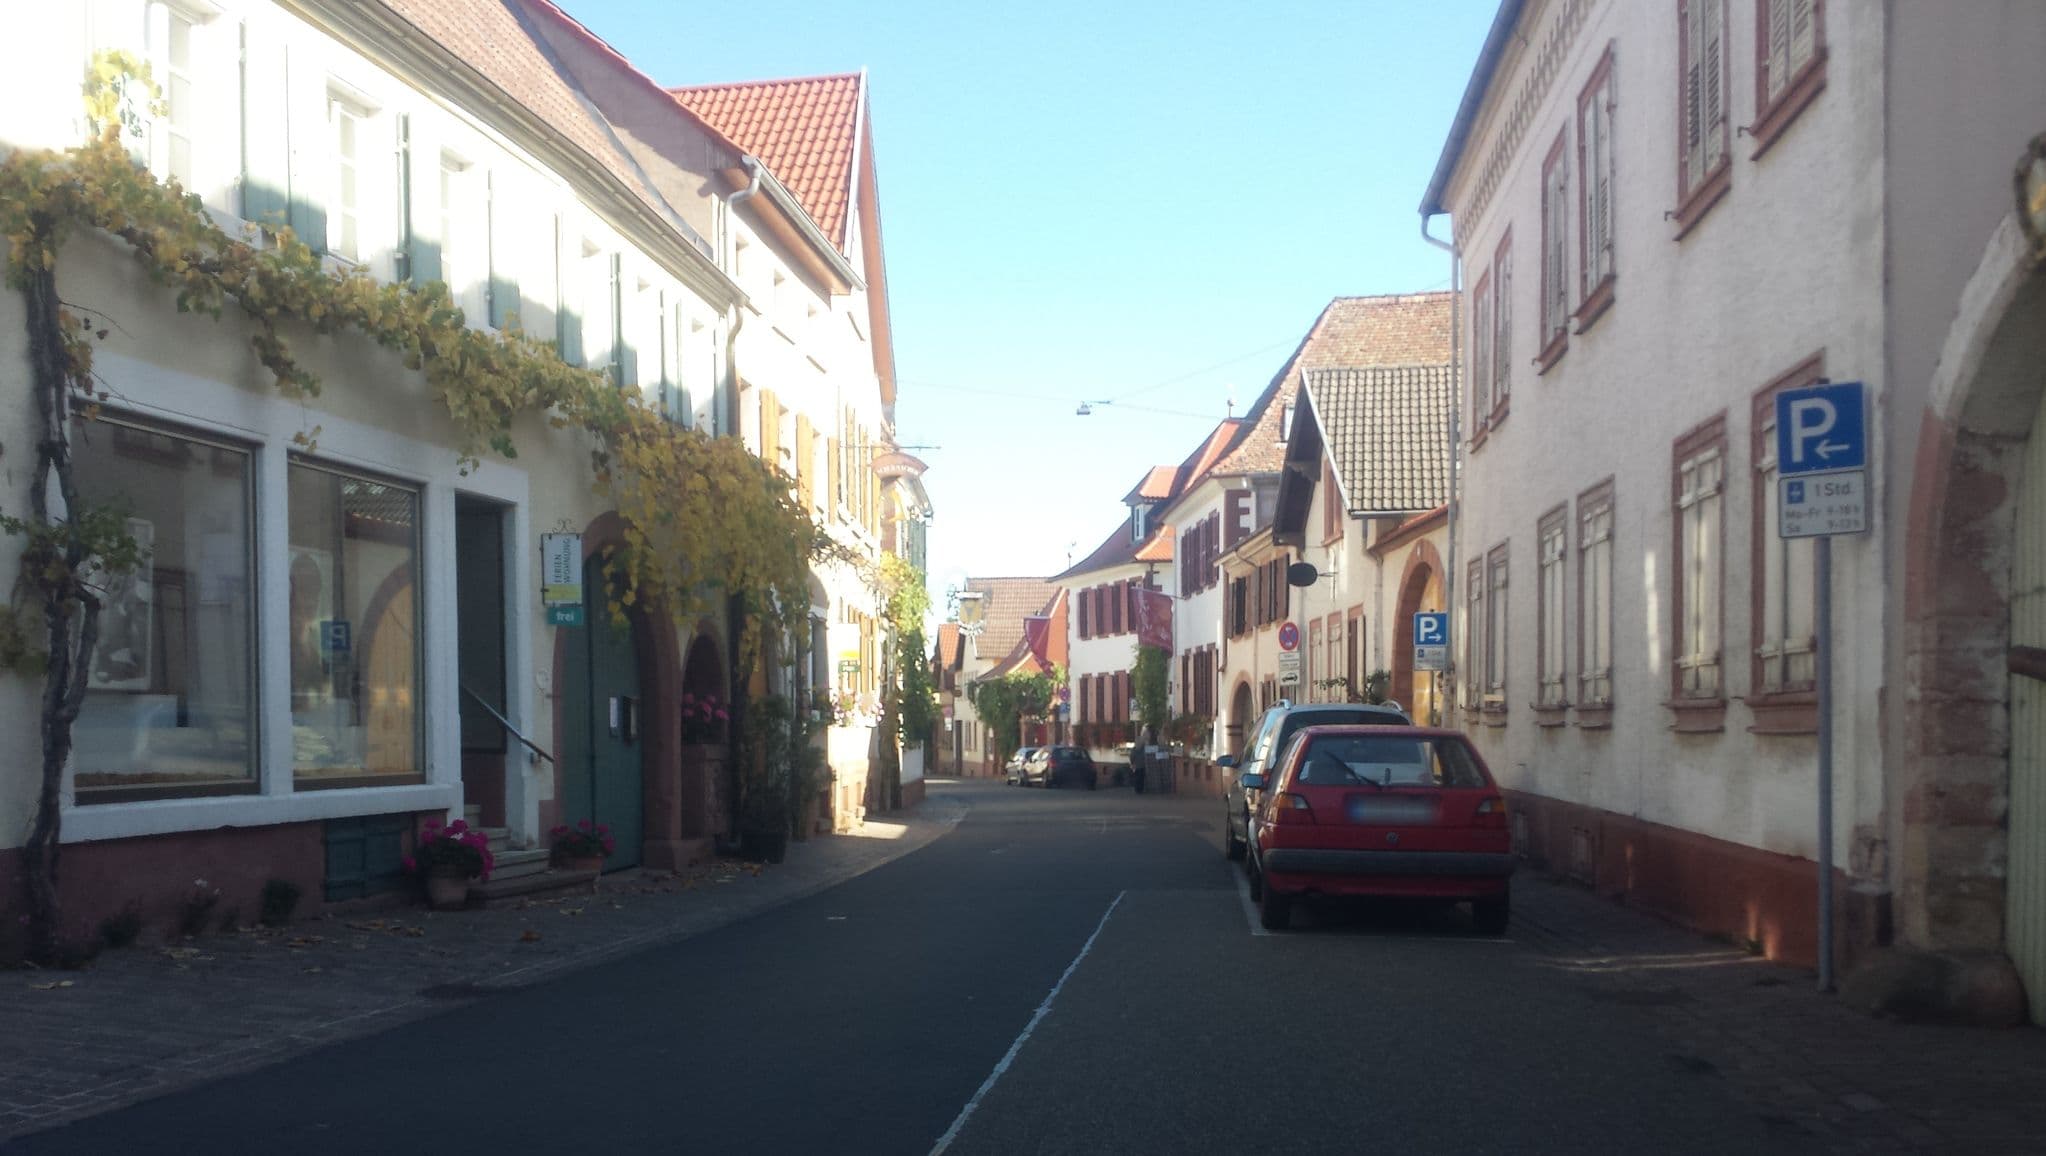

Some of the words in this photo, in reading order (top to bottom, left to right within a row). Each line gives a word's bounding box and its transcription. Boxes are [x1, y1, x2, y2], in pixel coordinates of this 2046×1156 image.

[1790, 397, 1837, 463] P
[553, 554, 562, 583] FERIEN
[563, 538, 571, 584] WOHNUNG
[556, 610, 574, 622] frei
[1420, 617, 1438, 642] P
